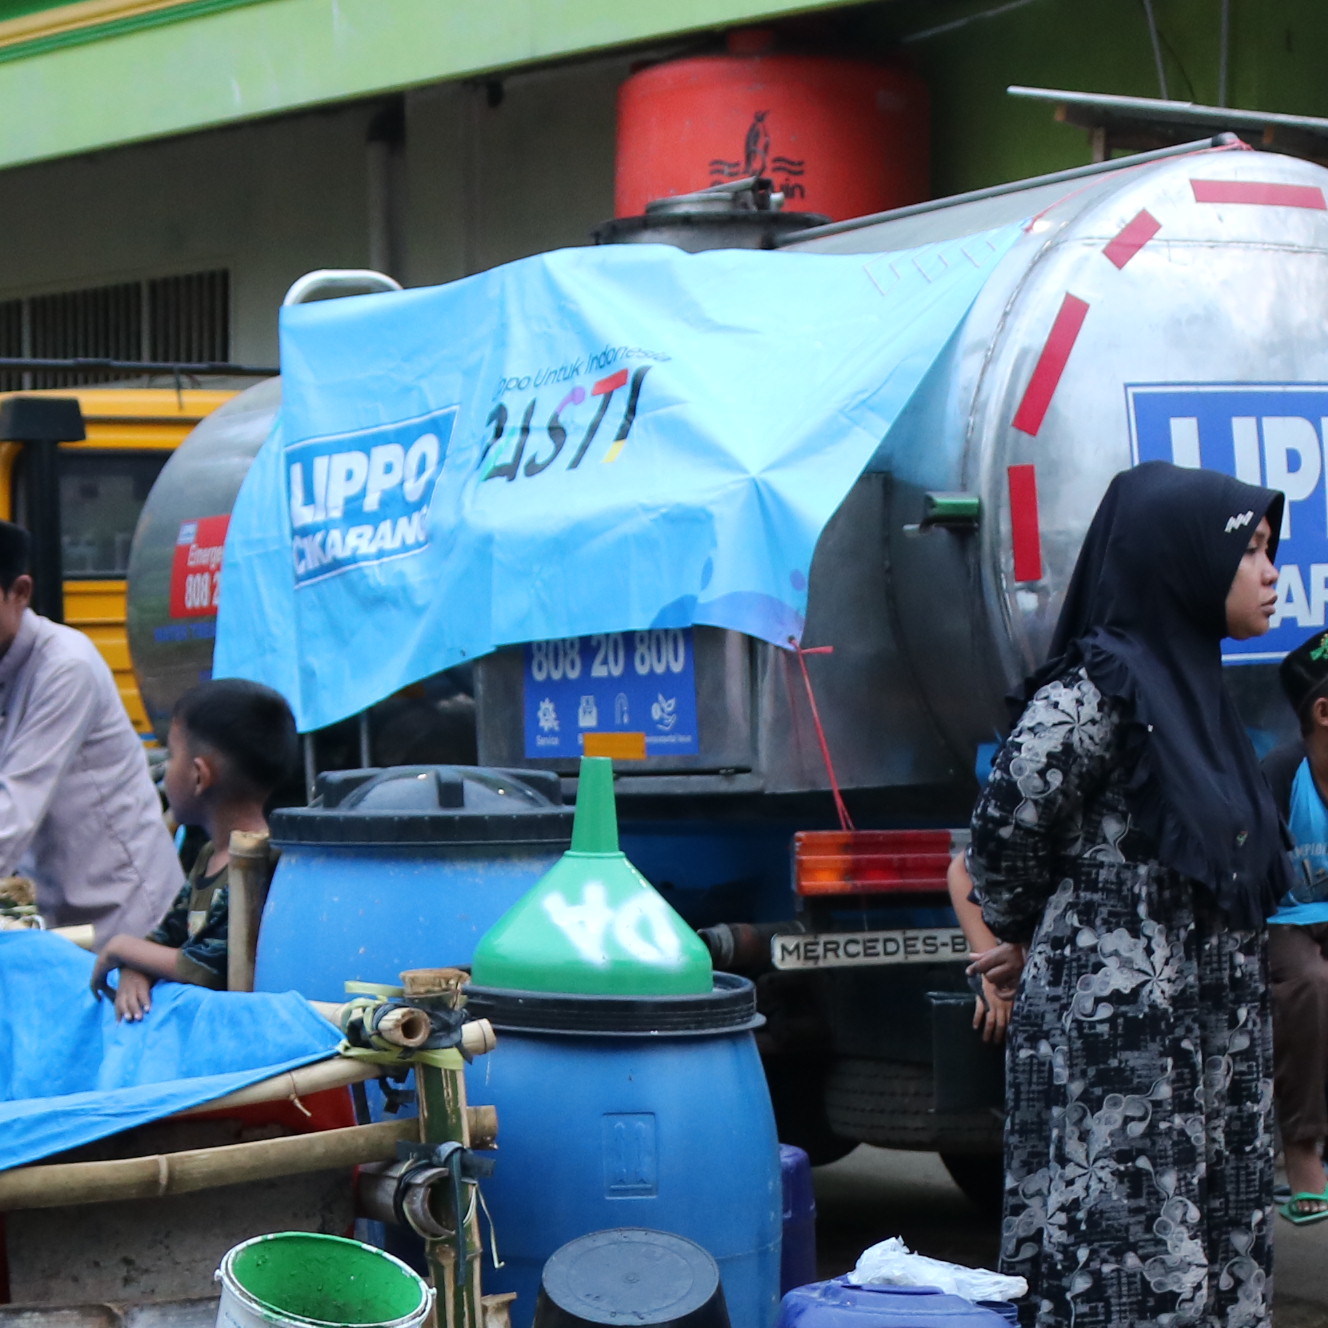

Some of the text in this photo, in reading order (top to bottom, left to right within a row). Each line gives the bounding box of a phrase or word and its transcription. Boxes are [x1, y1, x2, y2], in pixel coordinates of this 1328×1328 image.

[533, 357, 586, 388] Untuk
[289, 432, 440, 528] LIPPO
[292, 503, 429, 575] CIKARAN
[531, 627, 686, 682] 808 20 800
[780, 933, 969, 963] MERCEDES-B
